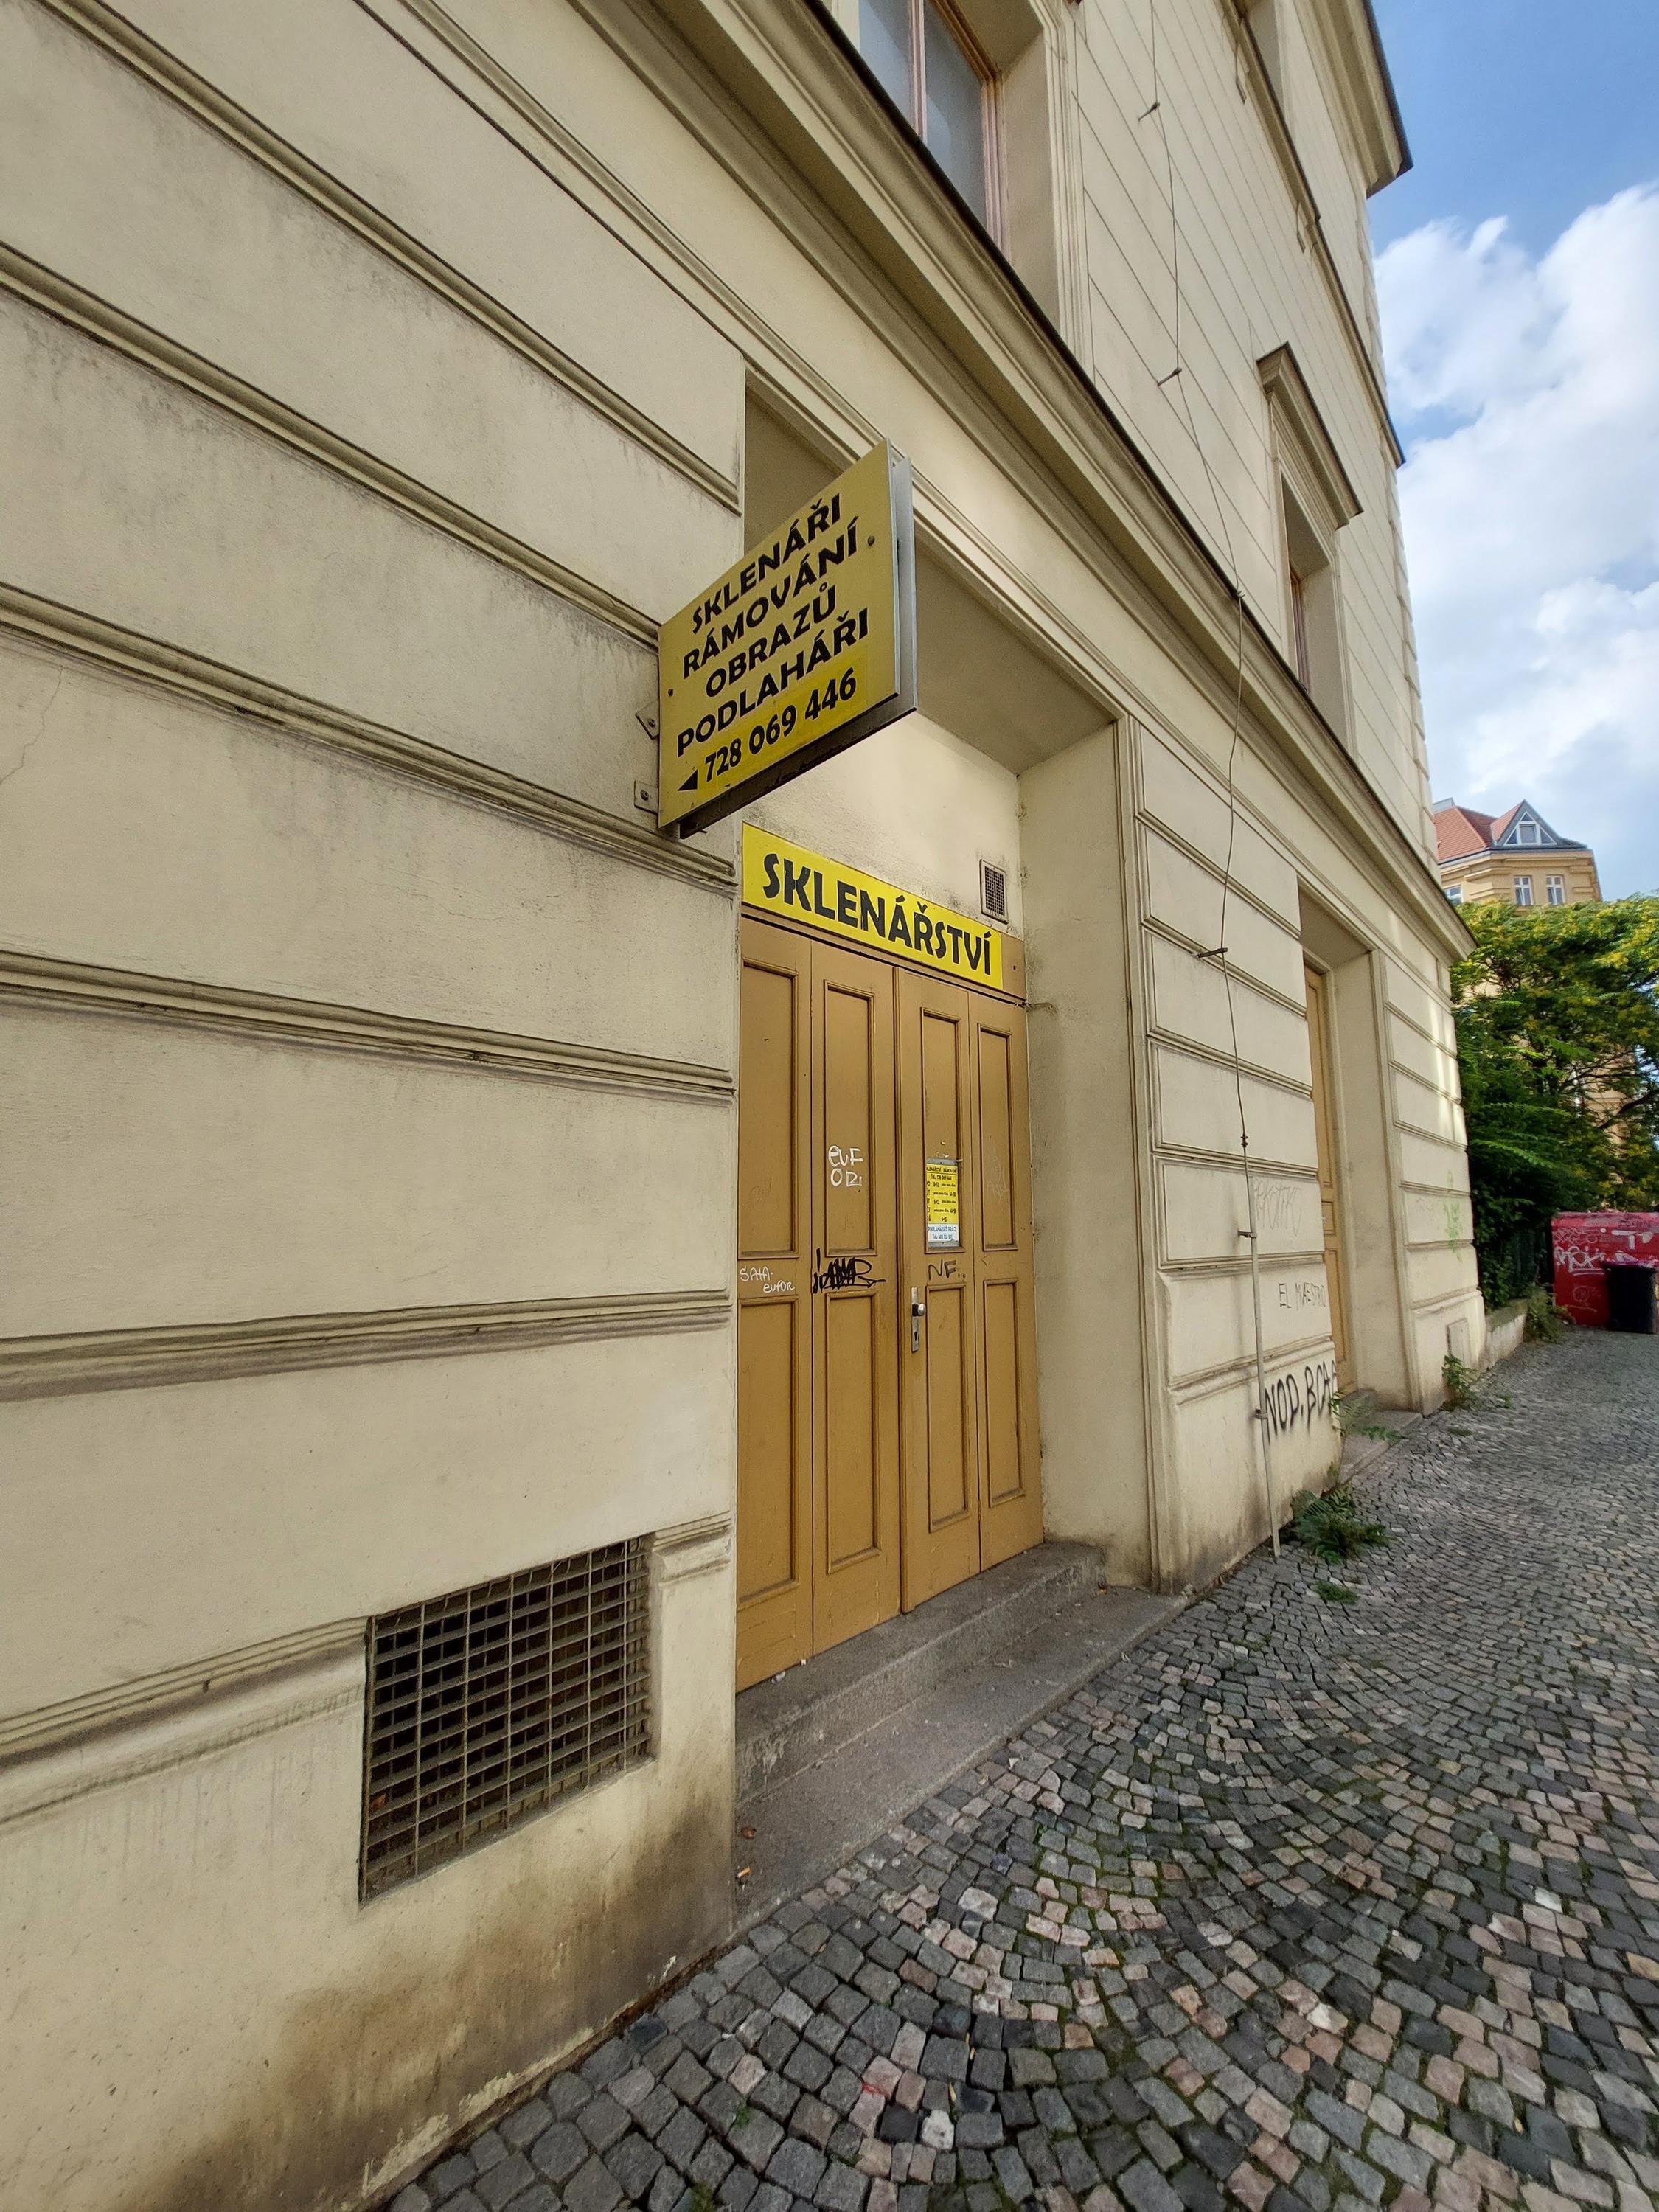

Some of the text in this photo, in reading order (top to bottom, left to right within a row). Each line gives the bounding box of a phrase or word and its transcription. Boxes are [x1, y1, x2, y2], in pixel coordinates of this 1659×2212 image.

[683, 516, 859, 679] RÁMOVÁNÍ
[692, 493, 841, 635] SKLENÁŘI
[676, 607, 869, 758] PODLAHÁŘI
[706, 582, 836, 698] OBRAZŮ
[703, 667, 858, 783] 728 069 446
[762, 852, 992, 975] SKLENÁŘSTVÍ
